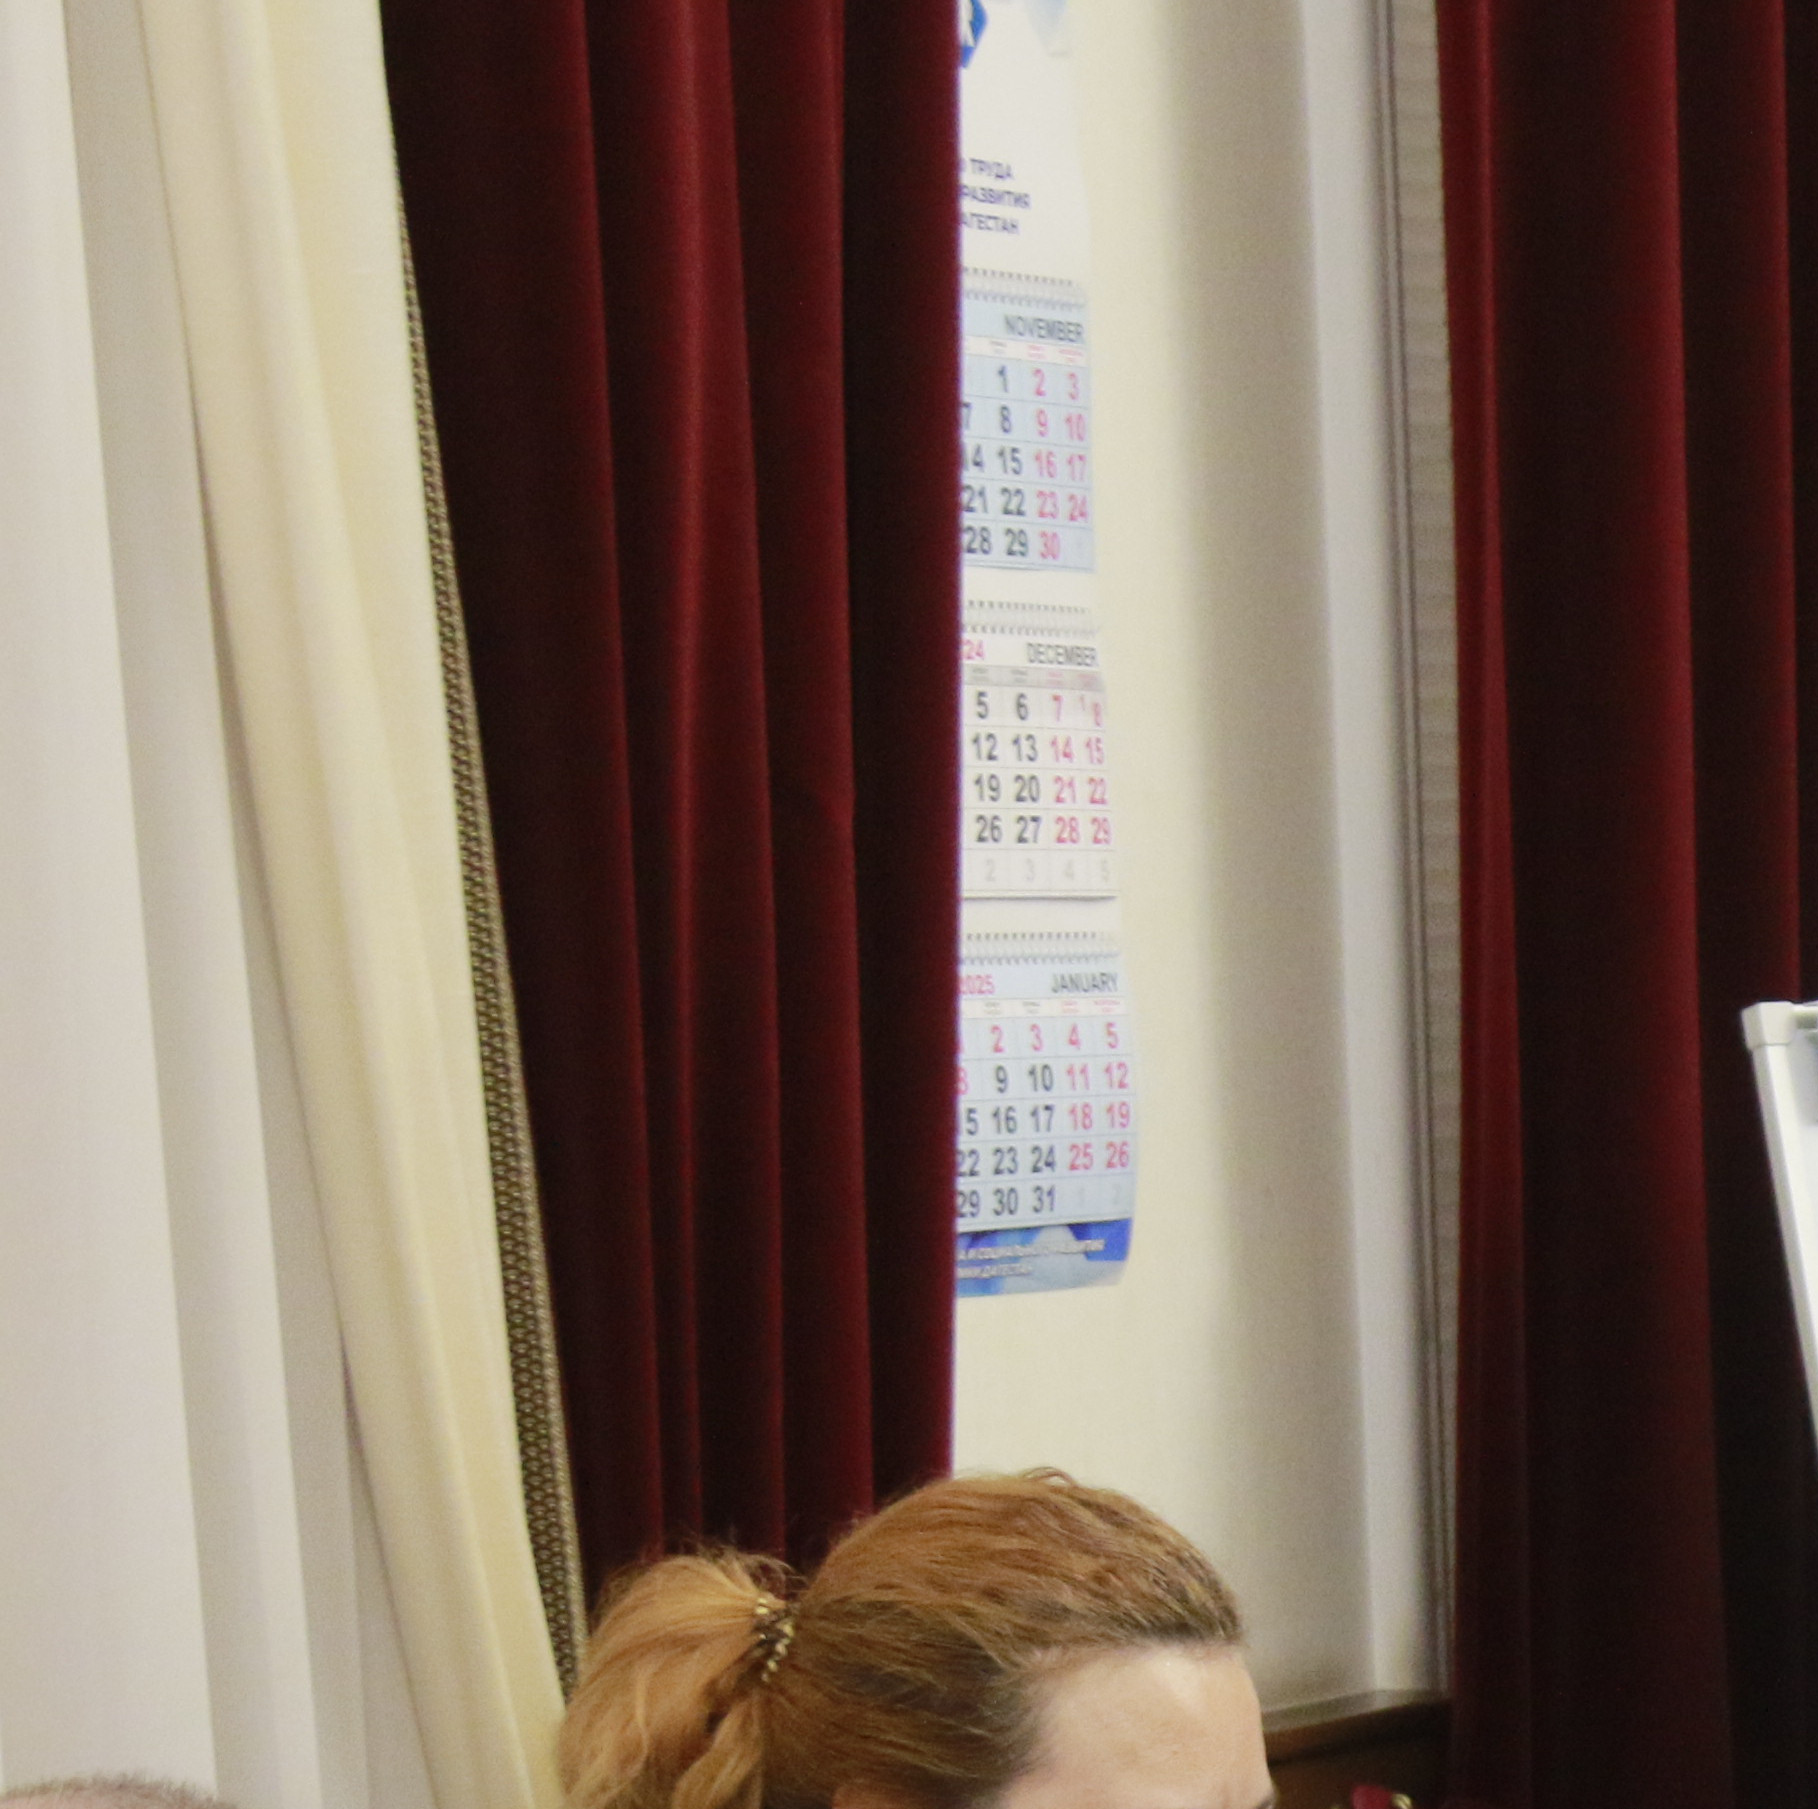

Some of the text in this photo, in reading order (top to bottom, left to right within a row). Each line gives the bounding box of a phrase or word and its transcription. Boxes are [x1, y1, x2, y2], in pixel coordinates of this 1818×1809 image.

[969, 158, 1015, 180] ТРУДА
[961, 212, 1020, 236] АГЕСТАН
[1004, 314, 1085, 344] NOVEMBER
[998, 365, 1079, 400] 1 2 3
[1000, 405, 1012, 434] 8
[1036, 408, 1048, 438] 9
[1065, 413, 1085, 441] 10
[998, 446, 1022, 475] 15
[1035, 449, 1057, 479] 16
[1067, 453, 1086, 481] 17
[963, 485, 1088, 523] 21 22 23 24
[963, 525, 1061, 560] 28 29 30
[961, 639, 1098, 667] 24 DECEMBER
[977, 691, 988, 719] 5
[1016, 692, 1028, 721] 6
[1052, 694, 1063, 722] 7
[972, 733, 1105, 765] 12 13 14 15
[974, 773, 1107, 805] 19 20 21 22
[976, 815, 1112, 845] 26 27 28 29
[1052, 972, 1118, 994] JANUARY
[990, 1021, 1119, 1053] 2 3 4 5
[995, 1065, 1009, 1094] 9
[1028, 1064, 1054, 1092] 10
[1066, 1063, 1091, 1091] 11
[1104, 1061, 1129, 1090] 12
[993, 1106, 1017, 1134] 16
[1031, 1104, 1055, 1133] 17
[1069, 1103, 1093, 1131] 18
[1107, 1101, 1131, 1129] 19
[958, 1141, 1130, 1177] 22 23 24 25 26
[958, 1189, 981, 1218] 29
[993, 1187, 1018, 1216] 30
[1033, 1185, 1056, 1214] 31
